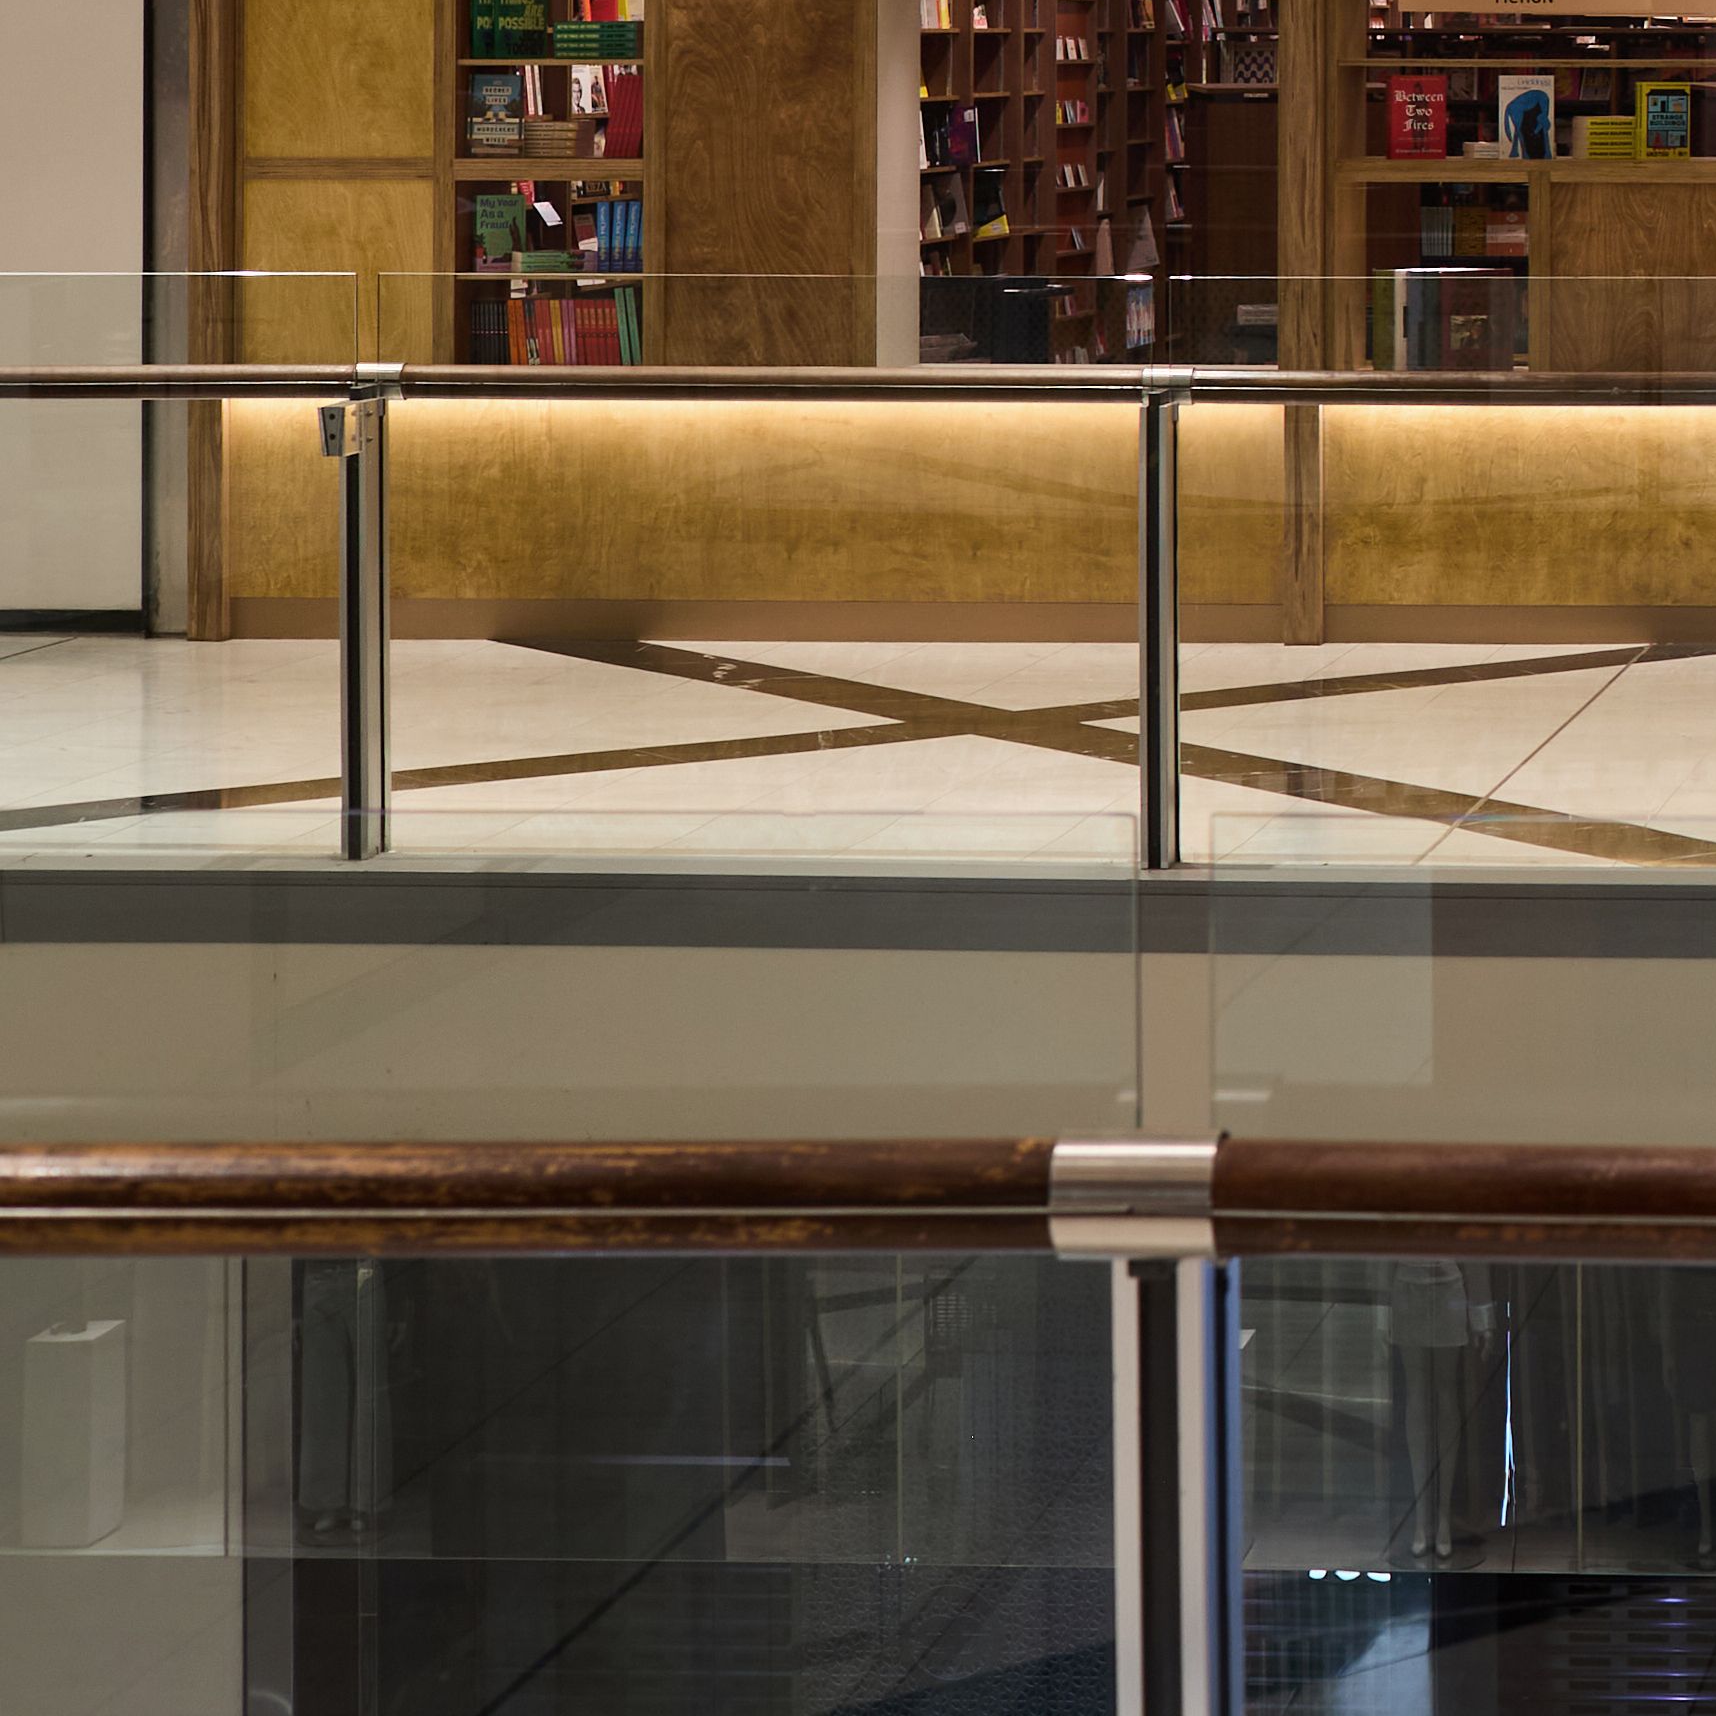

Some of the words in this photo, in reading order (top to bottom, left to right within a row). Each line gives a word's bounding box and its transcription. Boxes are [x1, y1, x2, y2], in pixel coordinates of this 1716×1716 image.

[524, 5, 545, 17] ARE
[498, 17, 545, 30] POSSIBLE
[1394, 90, 1444, 103] Between
[1405, 104, 1433, 117] Two
[1403, 119, 1435, 132] Fires
[480, 198, 495, 209] My
[498, 199, 519, 207] Year
[480, 210, 493, 219] As
[480, 221, 511, 230] Fraud
